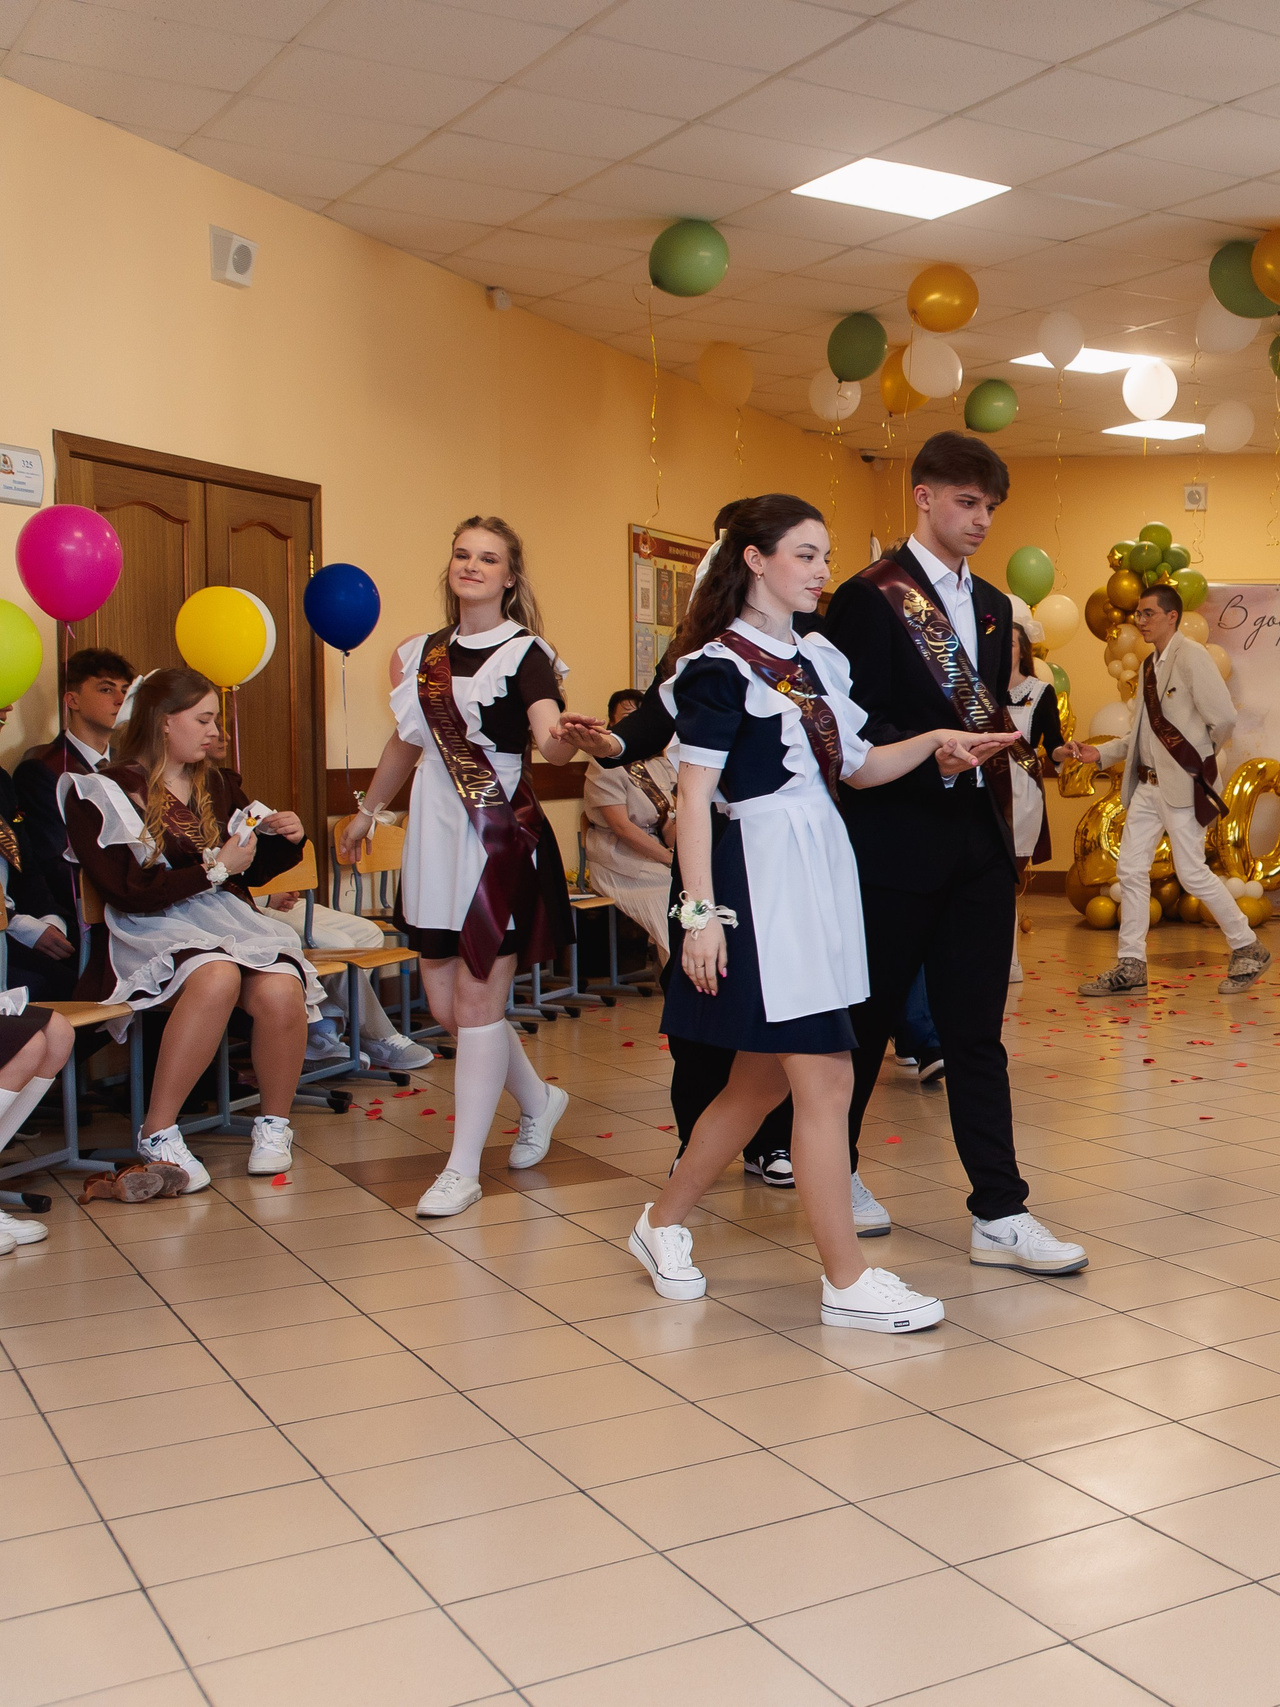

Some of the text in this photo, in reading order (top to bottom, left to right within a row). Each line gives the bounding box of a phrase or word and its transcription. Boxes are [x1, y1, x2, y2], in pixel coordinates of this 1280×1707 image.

[1218, 594, 1249, 630] В
[922, 620, 994, 732] Выпускни
[462, 770, 504, 808] 2024
